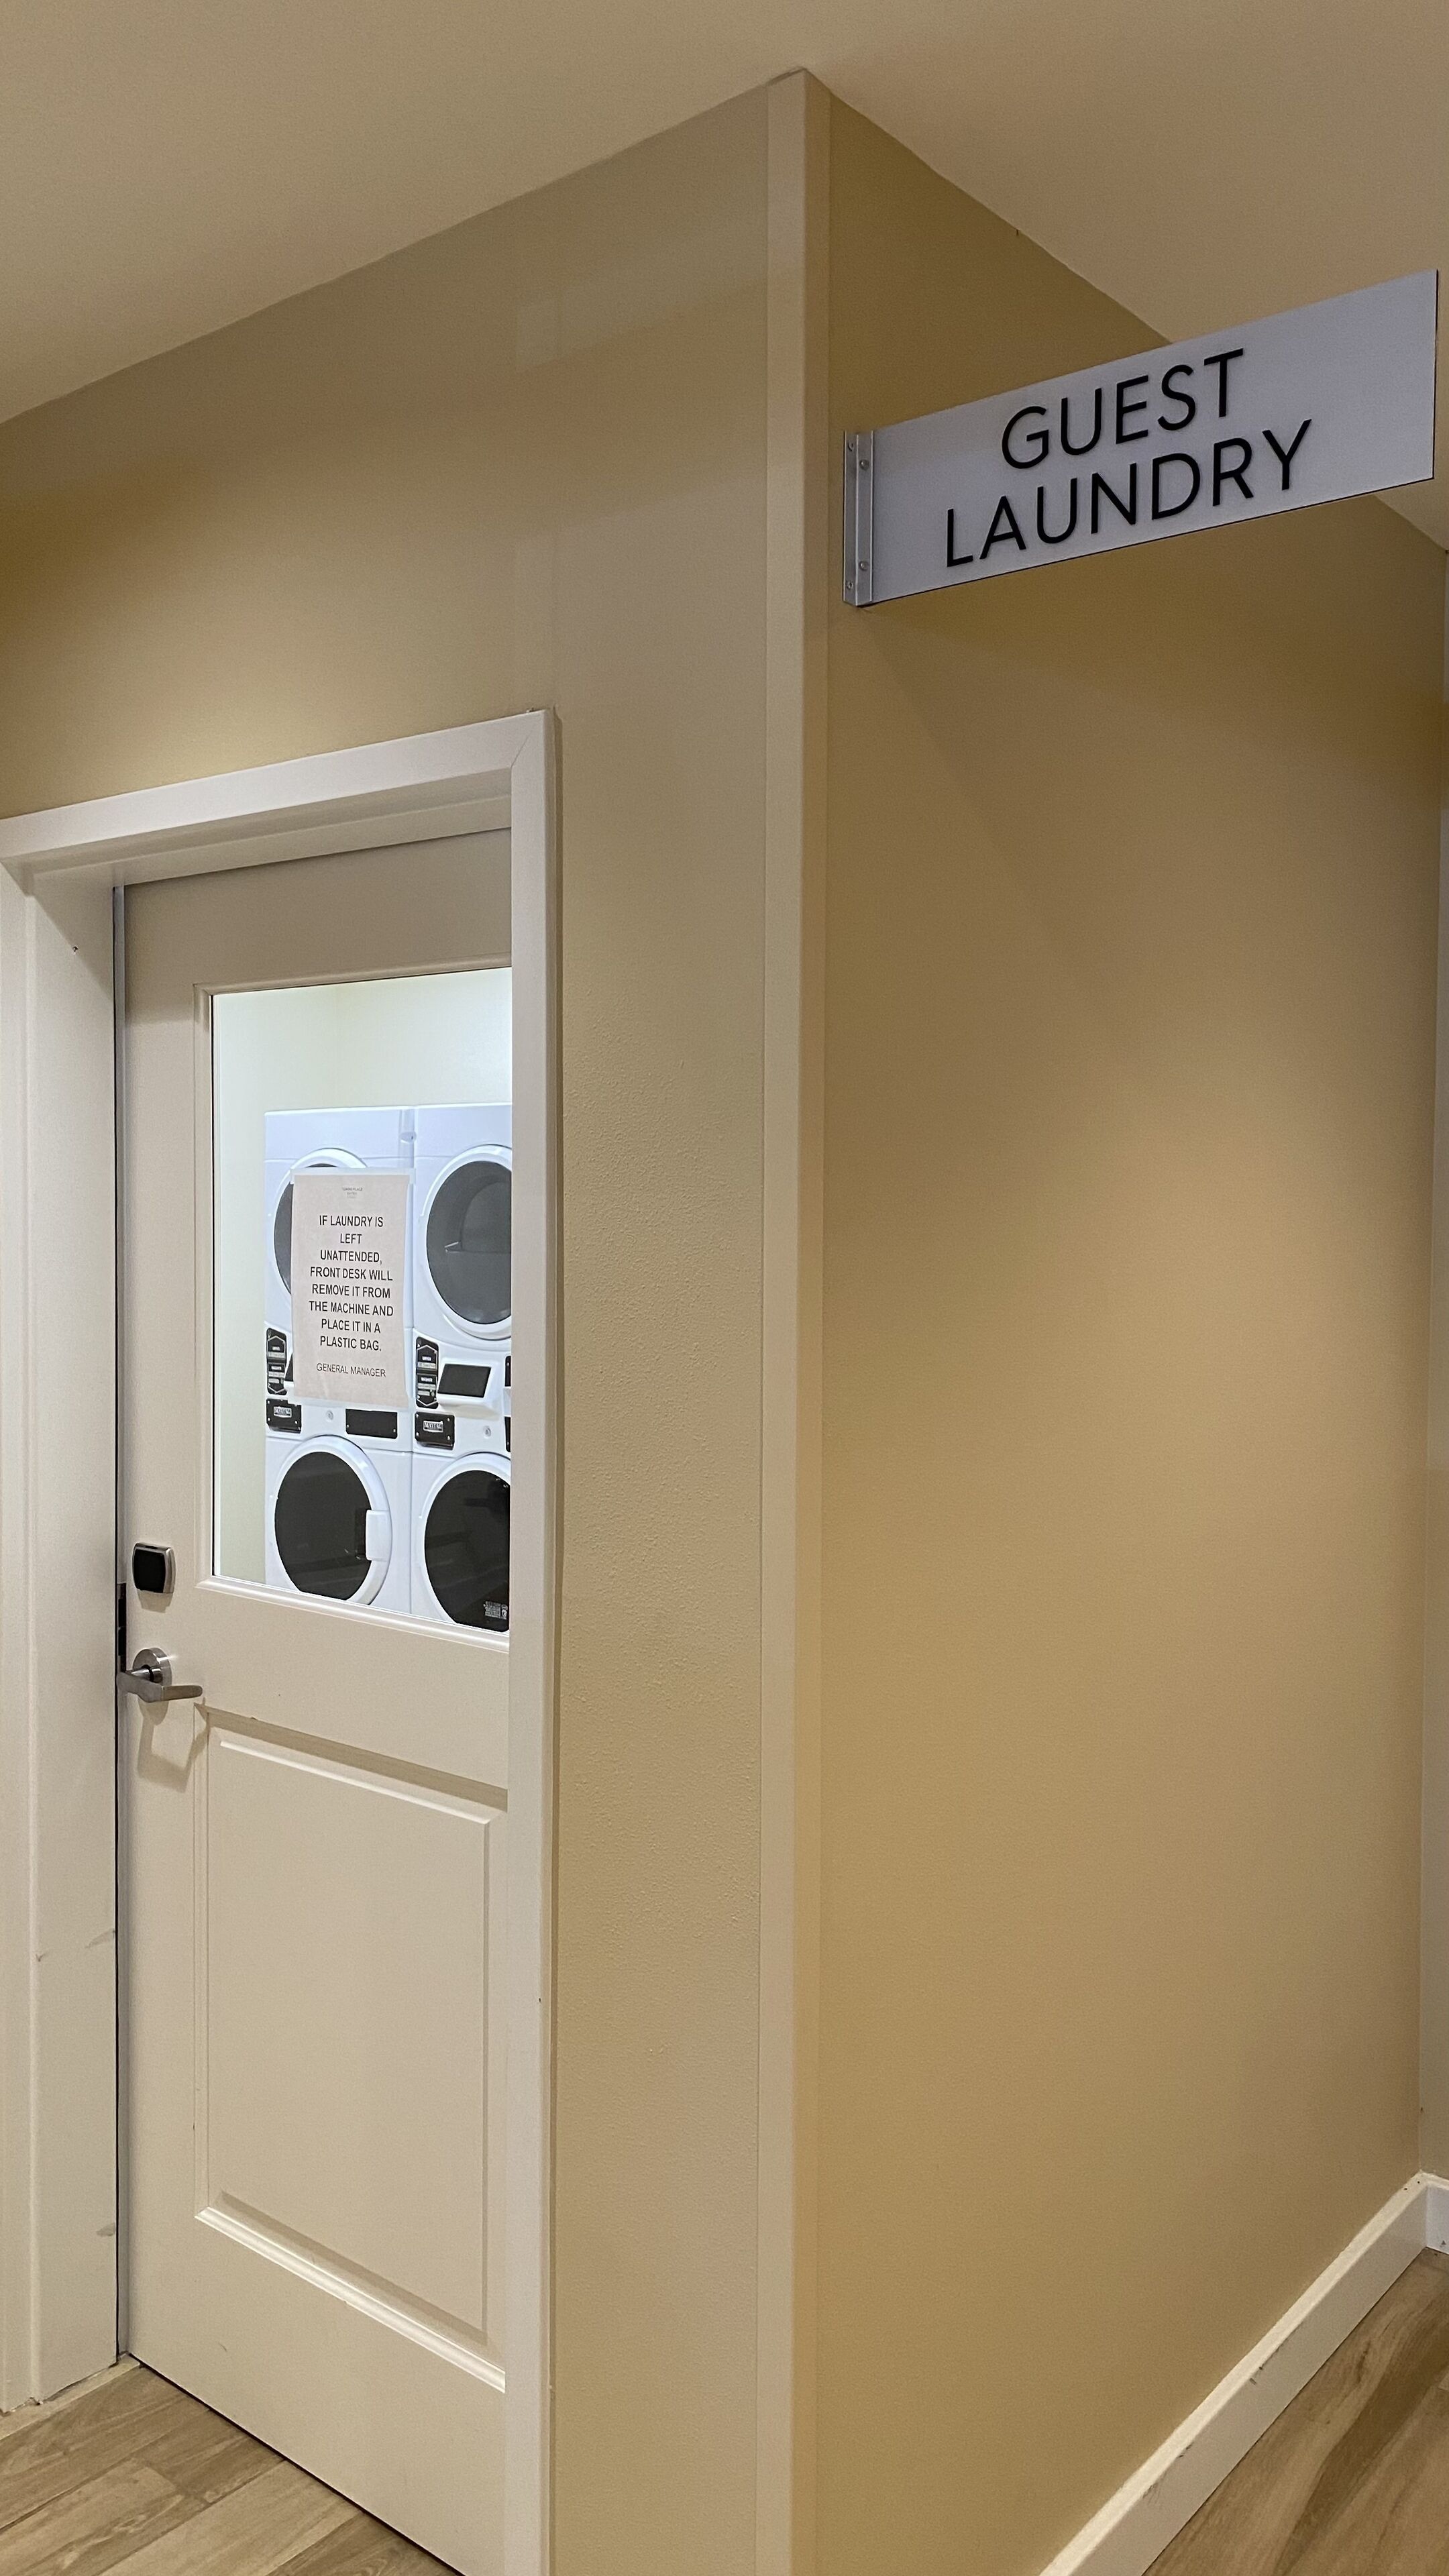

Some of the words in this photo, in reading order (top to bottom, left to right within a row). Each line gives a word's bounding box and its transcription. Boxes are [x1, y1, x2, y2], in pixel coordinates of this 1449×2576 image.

[1002, 347, 1244, 470] GUEST
[946, 418, 1313, 568] LAUNDRY
[319, 1215, 327, 1226] IF
[330, 1216, 372, 1227] LAUNDRY
[375, 1216, 383, 1227] IS
[340, 1233, 362, 1244] LEFT
[320, 1249, 382, 1265] UNATTENDED,
[310, 1267, 341, 1278] FRONT
[343, 1268, 366, 1279] DESK
[369, 1269, 393, 1281] WILL
[312, 1283, 350, 1296] REMOVE
[352, 1286, 360, 1297] IT
[362, 1287, 390, 1298] FROM
[309, 1301, 328, 1311] THE
[330, 1302, 370, 1315] MACHINE
[372, 1305, 394, 1316] AND
[321, 1318, 350, 1330] PLACE
[352, 1321, 360, 1332] IT
[363, 1322, 372, 1332] IN
[374, 1323, 381, 1334] A
[320, 1336, 357, 1348] PLASTIC
[360, 1339, 382, 1351] BAG.
[316, 1362, 349, 1374] GENERAL
[350, 1366, 386, 1377] MANAGER
[424, 1421, 442, 1430] MAYTAG
